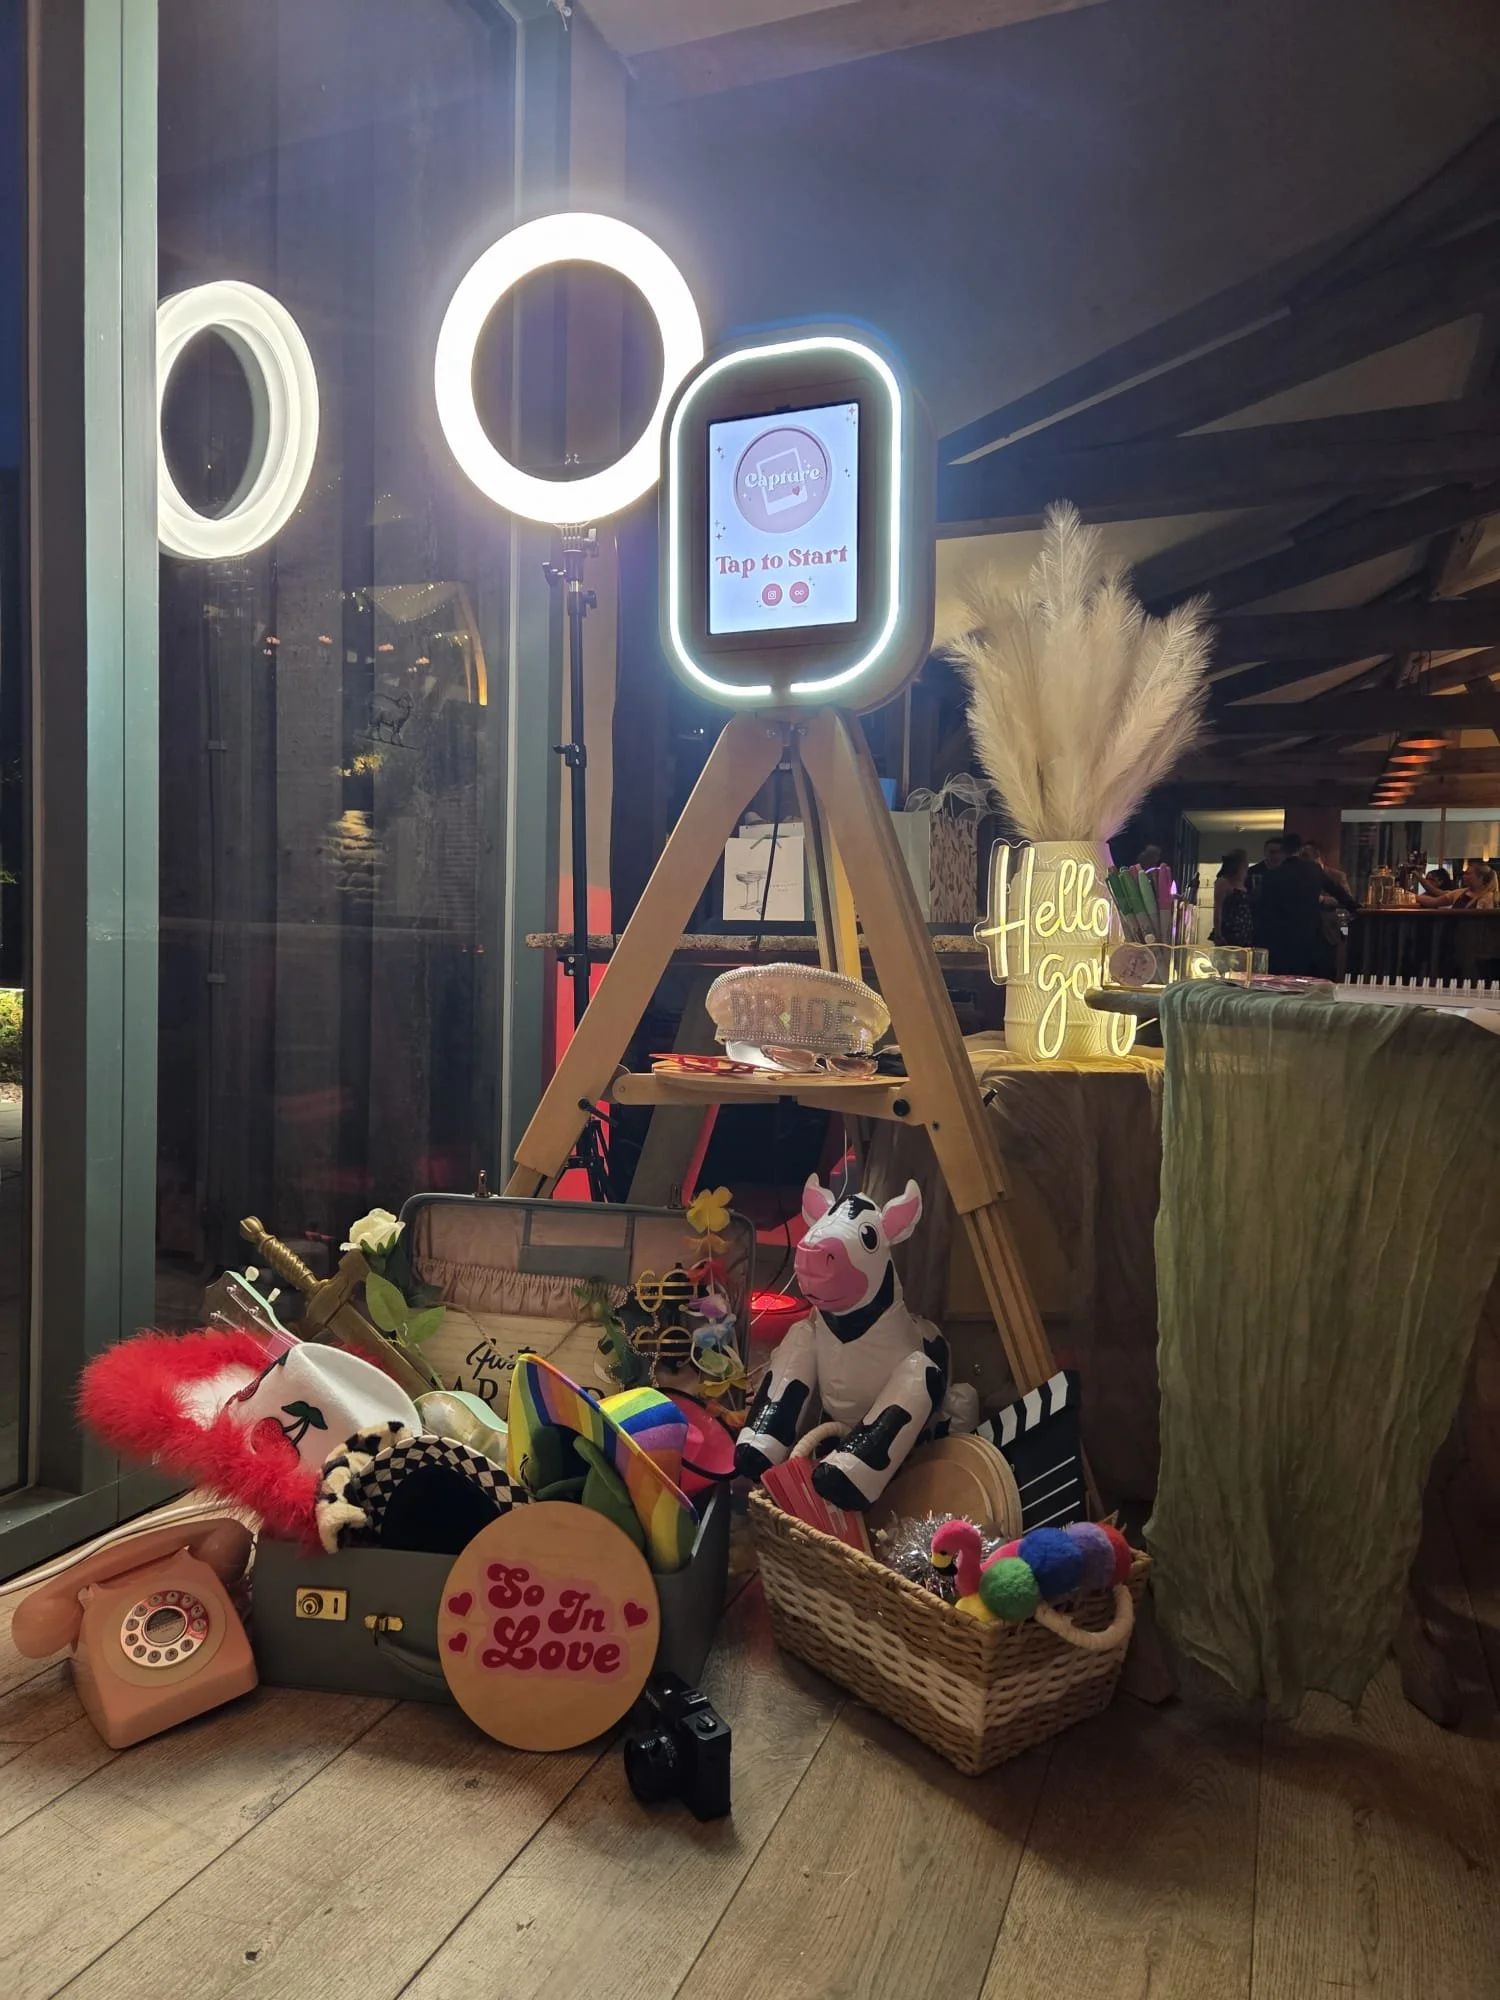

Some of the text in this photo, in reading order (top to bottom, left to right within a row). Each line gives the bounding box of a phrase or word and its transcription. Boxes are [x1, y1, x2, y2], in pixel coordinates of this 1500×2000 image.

[744, 467, 821, 492] Capture
[715, 545, 849, 579] Tap to Start
[977, 844, 1110, 979] Hello
[730, 989, 858, 1041] BRIDE
[487, 1563, 606, 1634] So In
[481, 1614, 621, 1674] Love
